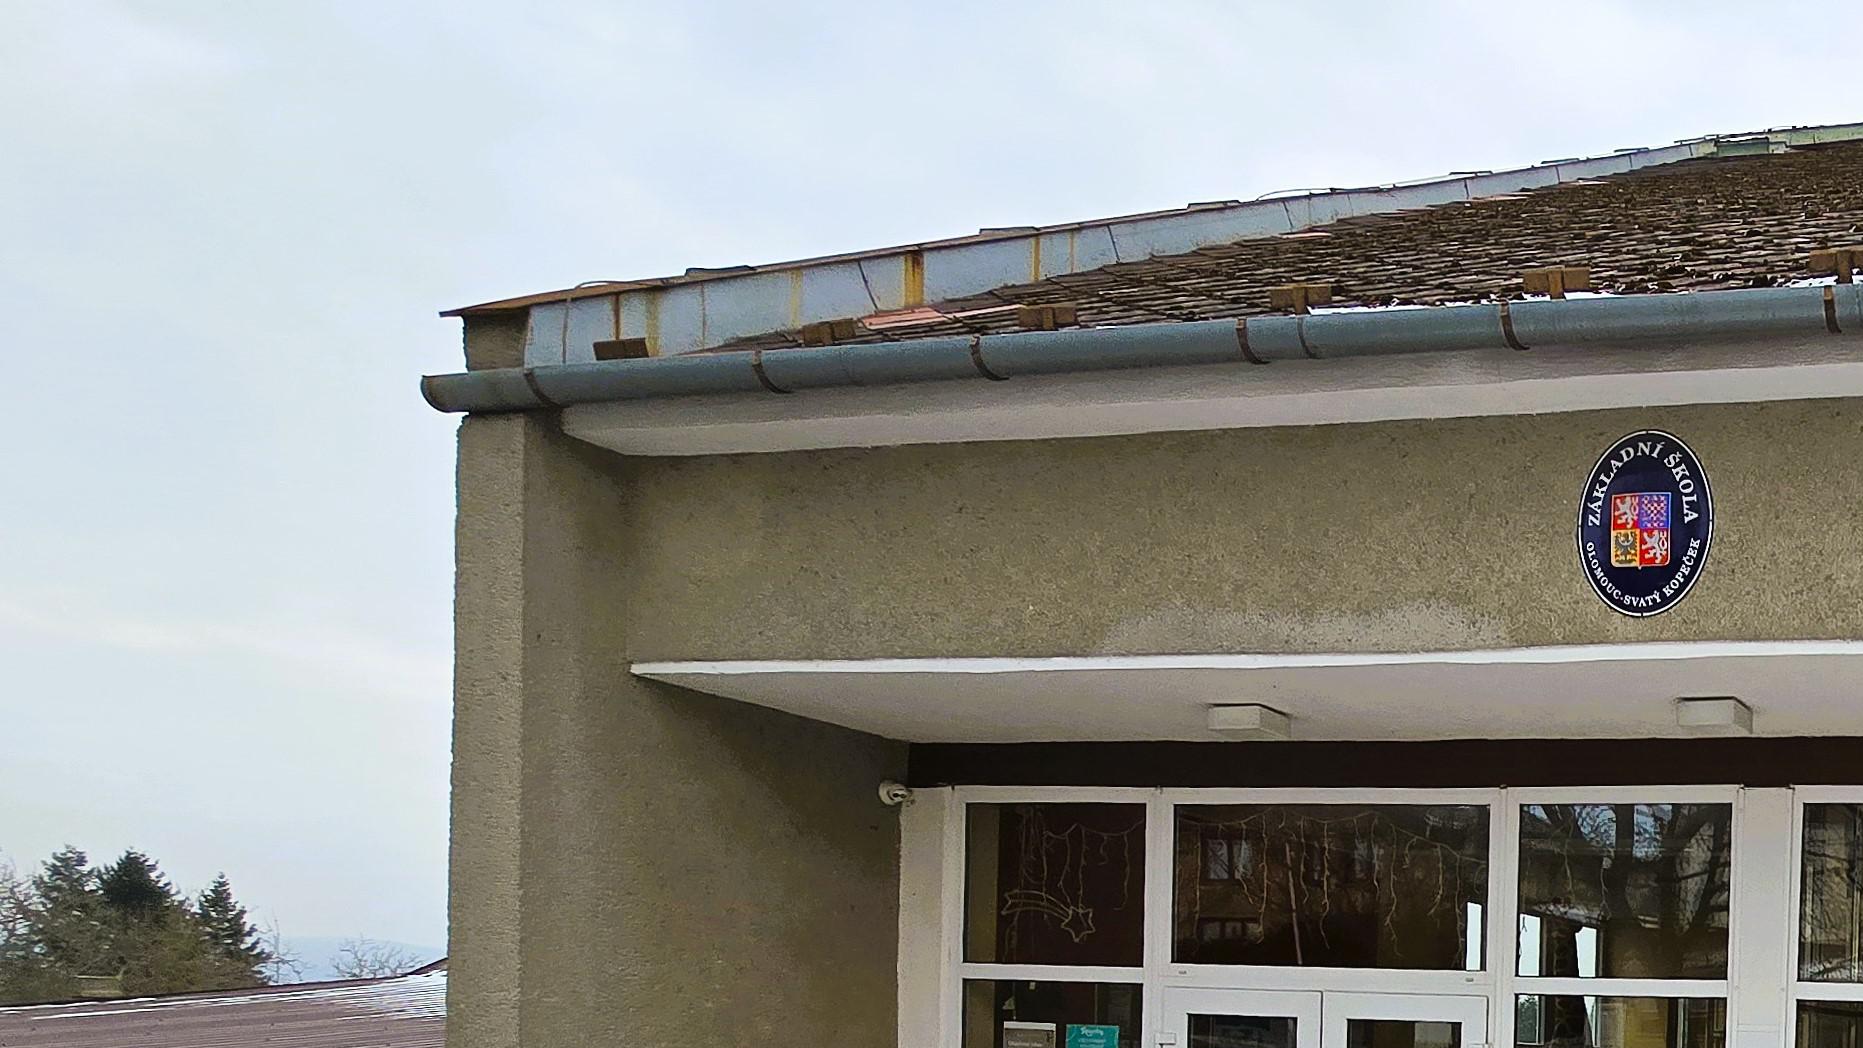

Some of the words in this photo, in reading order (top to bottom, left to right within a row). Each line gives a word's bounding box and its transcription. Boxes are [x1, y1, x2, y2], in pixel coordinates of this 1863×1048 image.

[1587, 441, 1666, 527] ZÁKLADNÍ
[1664, 451, 1699, 525] ŠKOLA
[1663, 537, 1701, 597] KOPEČEK
